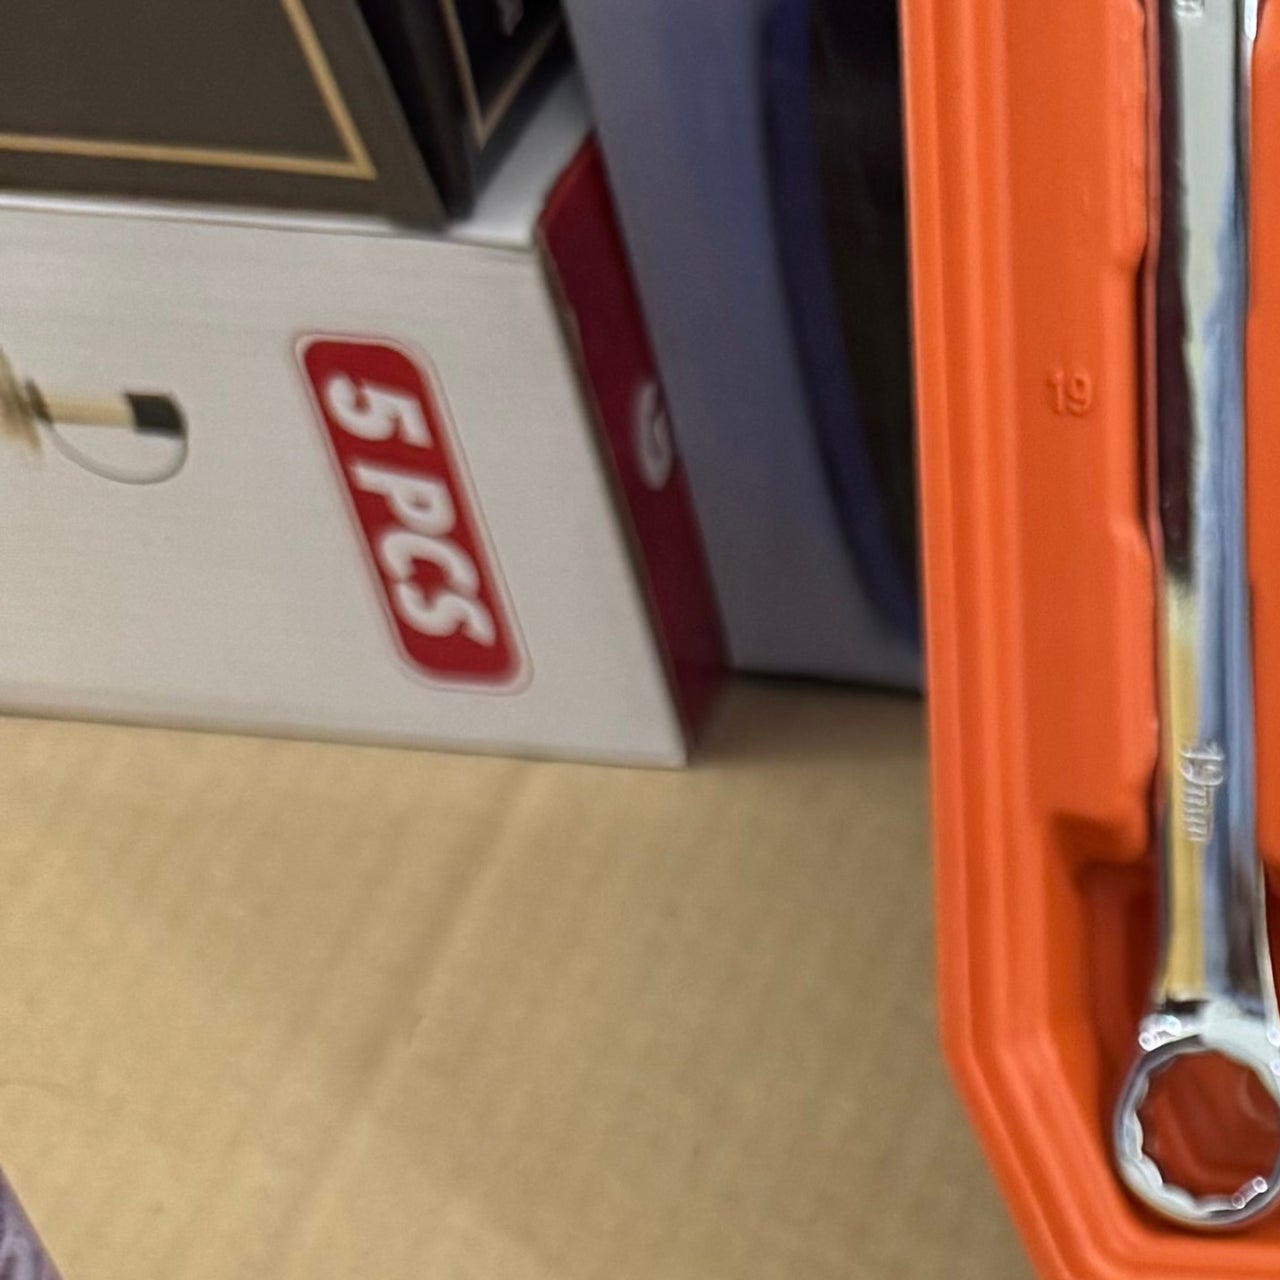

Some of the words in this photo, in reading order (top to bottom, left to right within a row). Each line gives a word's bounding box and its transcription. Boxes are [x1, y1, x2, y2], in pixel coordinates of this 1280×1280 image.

[326, 373, 431, 451] 5
[1046, 369, 1092, 417] 19
[347, 460, 497, 648] PCS
